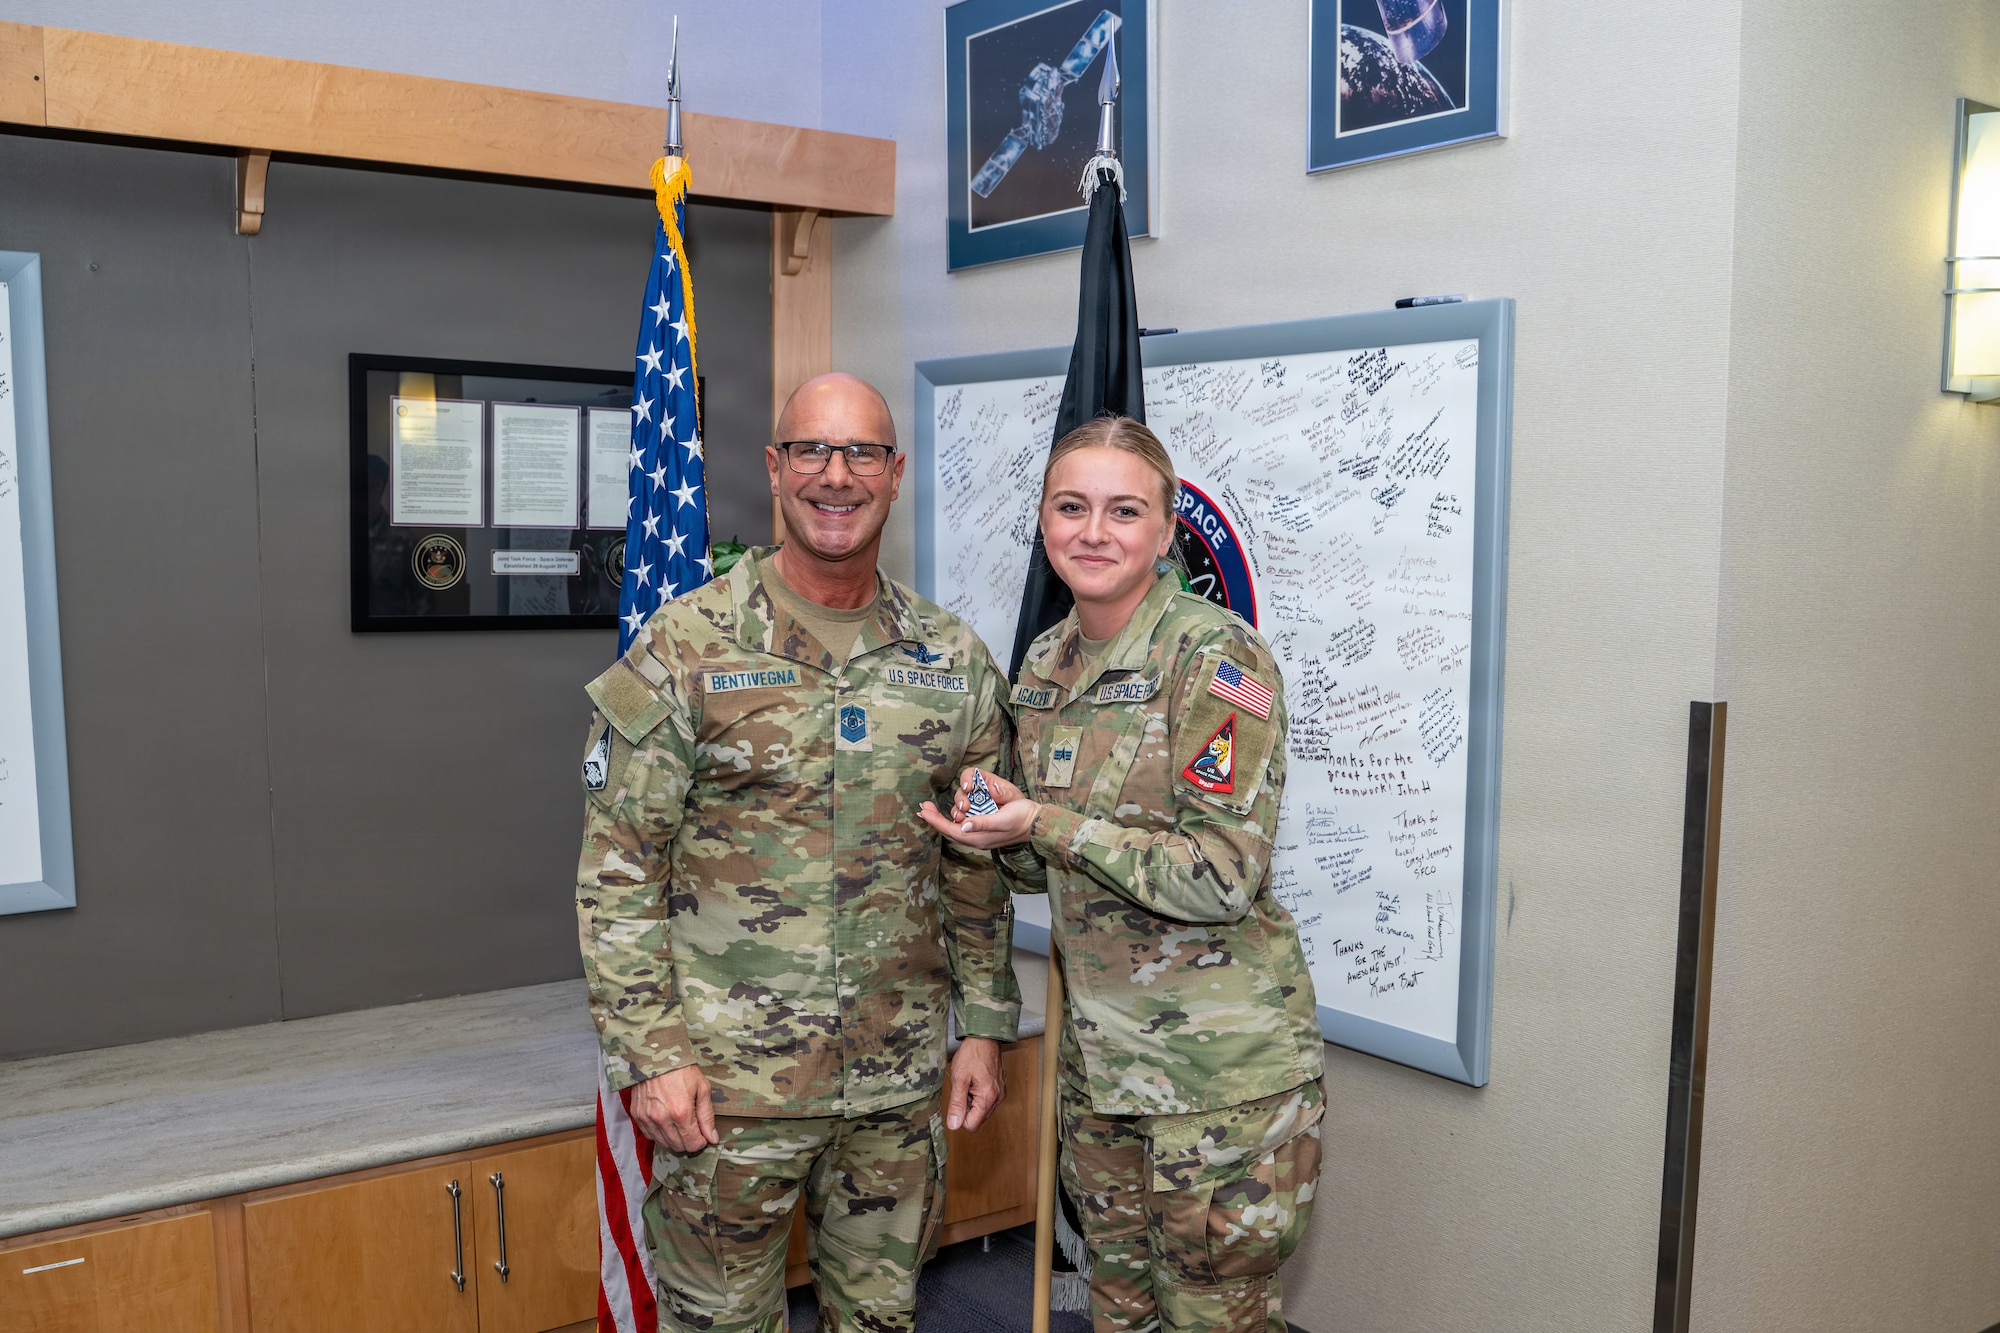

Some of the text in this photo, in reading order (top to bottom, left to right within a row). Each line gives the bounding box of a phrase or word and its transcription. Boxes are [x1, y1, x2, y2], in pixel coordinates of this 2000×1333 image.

[1177, 376, 1193, 388] Navy
[1173, 488, 1227, 550] SPACE
[540, 556, 555, 564] Space
[1298, 652, 1321, 668] Thank
[711, 669, 796, 690] BENTIVEGNA
[889, 668, 965, 691] U.S. SPACE FORCE
[1114, 683, 1143, 699] SPACE
[1326, 695, 1347, 709] Thanks
[1322, 747, 1364, 767] Thanks
[1370, 753, 1390, 767] for
[1394, 752, 1413, 767] the
[1195, 769, 1208, 777] SPACE
[1327, 770, 1360, 783] great
[1367, 770, 1395, 783] team
[1198, 779, 1215, 788] SPACE
[1333, 780, 1431, 797] teamwork! John H
[1393, 810, 1438, 828] Thanks for
[1426, 844, 1453, 860] Jennings
[1333, 939, 1364, 957] THANKS
[1355, 945, 1387, 967] FOR THE
[1347, 947, 1406, 985] AWESOME VISIT!
